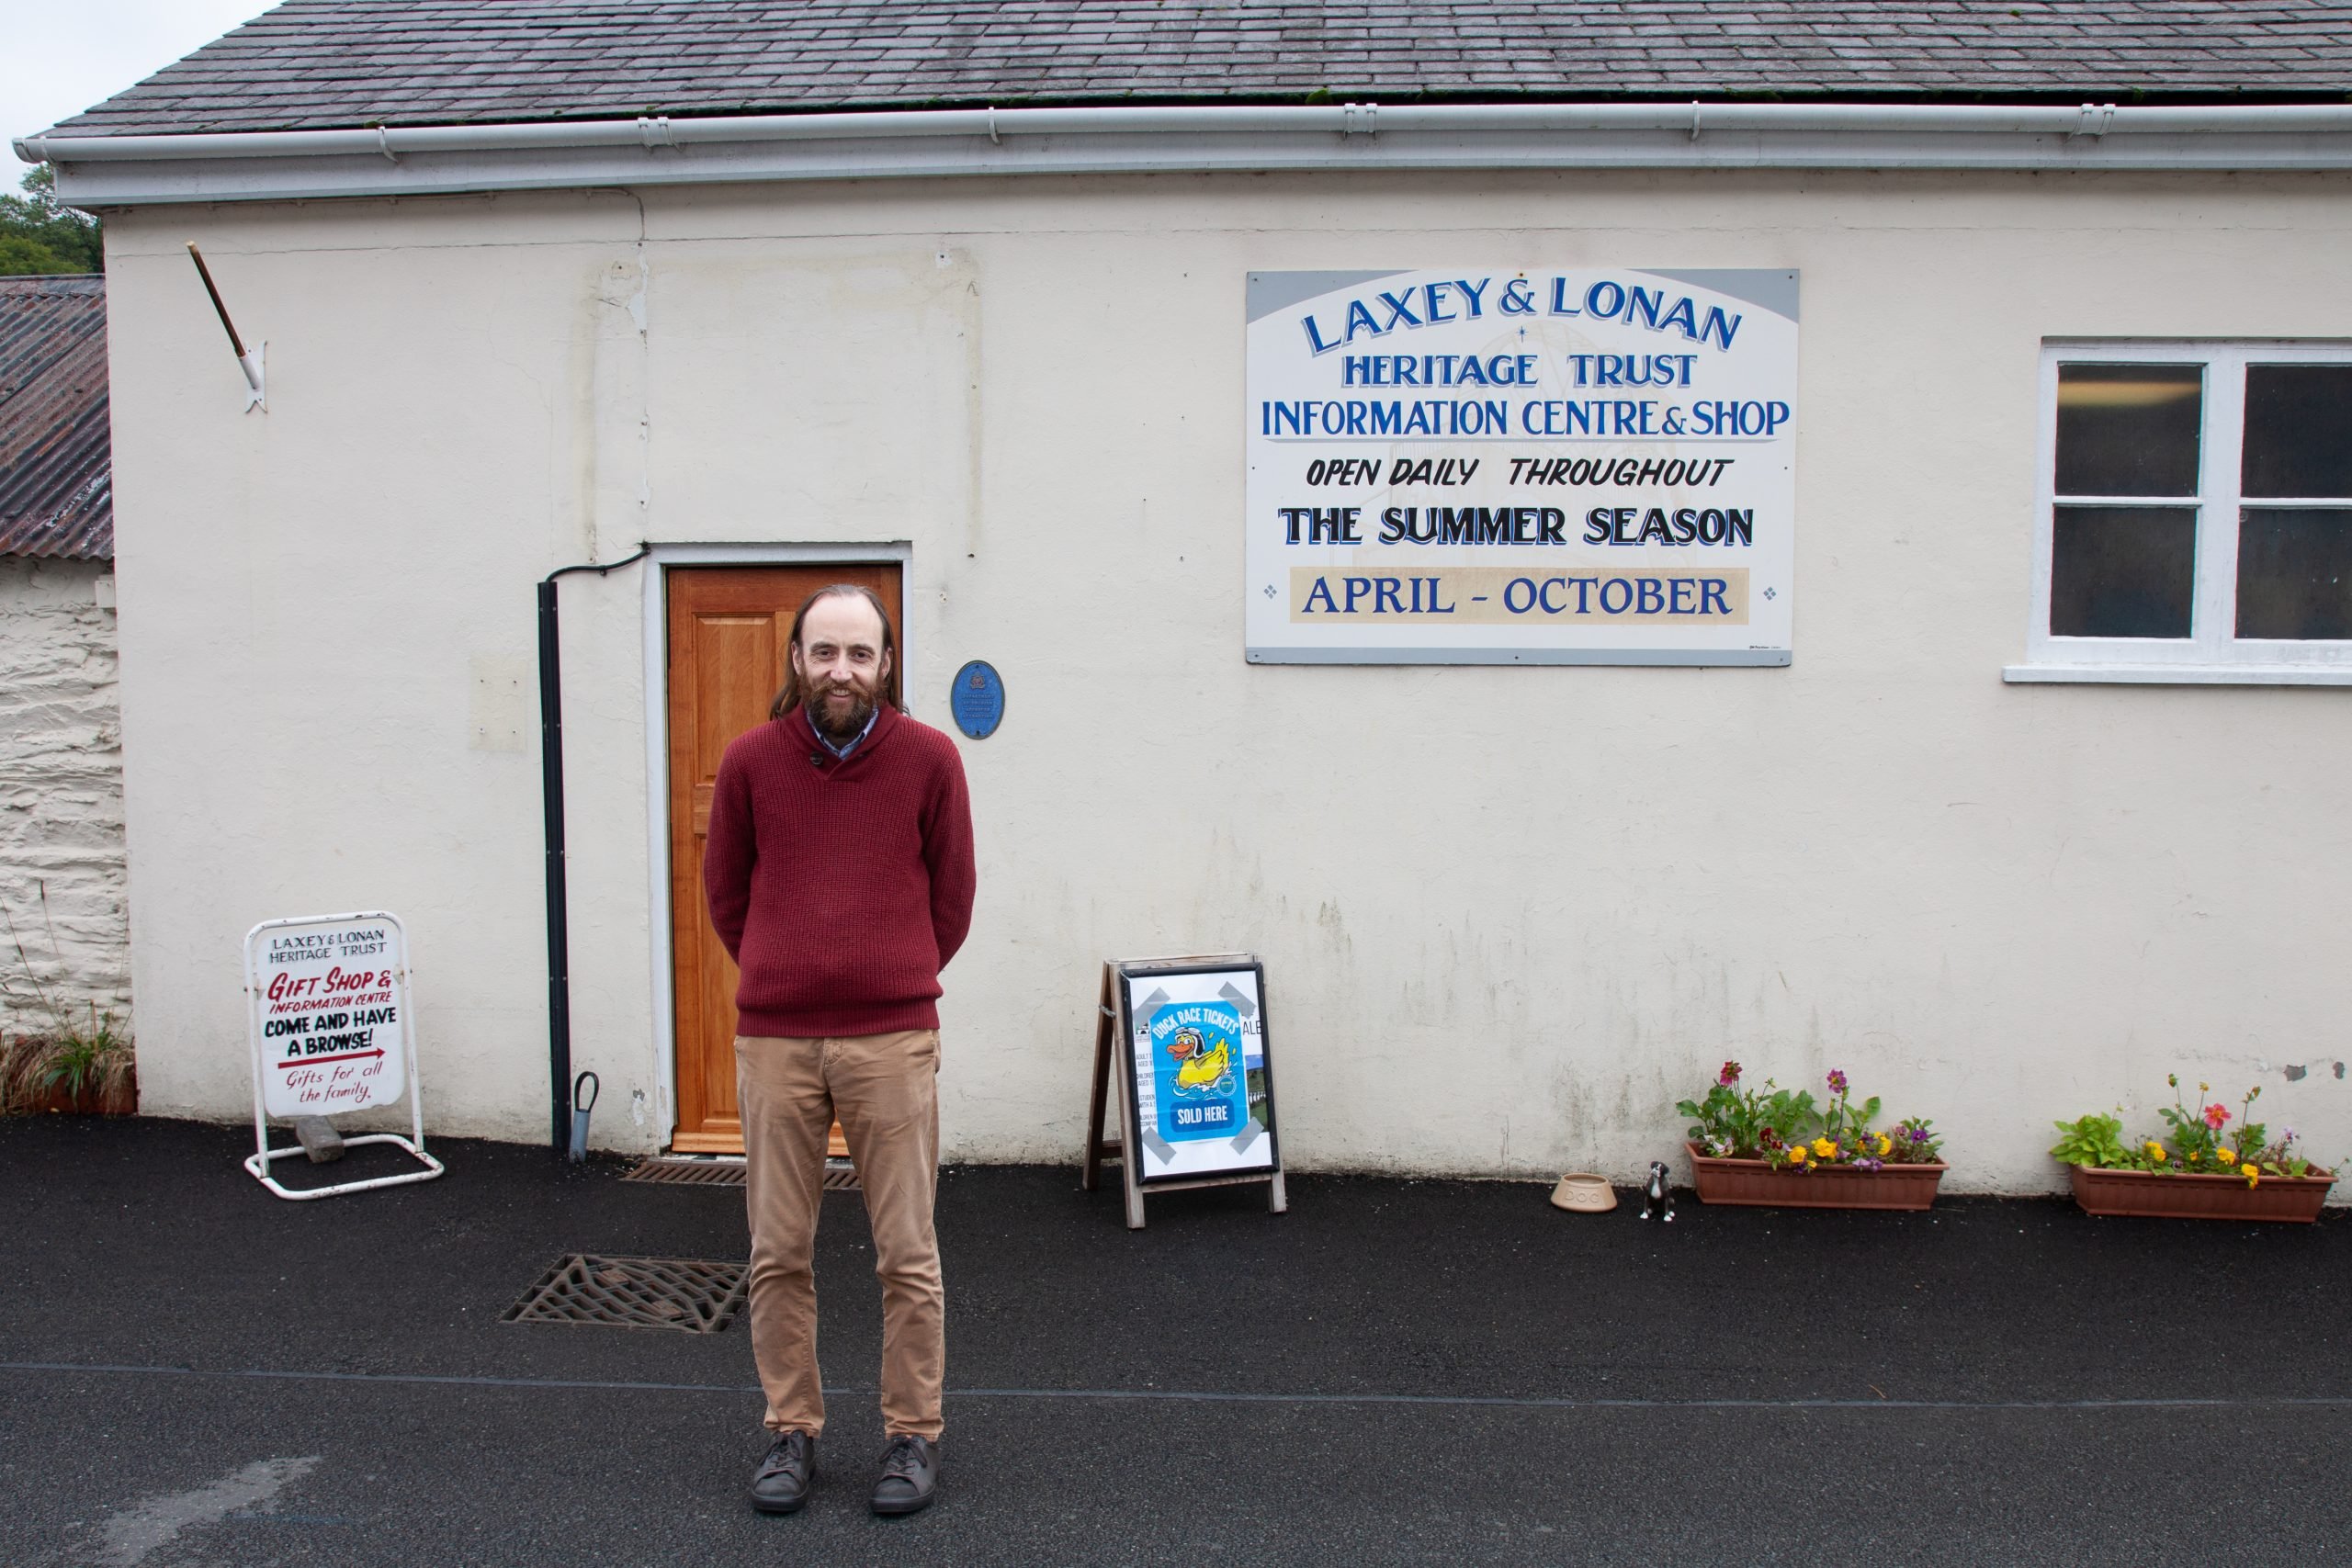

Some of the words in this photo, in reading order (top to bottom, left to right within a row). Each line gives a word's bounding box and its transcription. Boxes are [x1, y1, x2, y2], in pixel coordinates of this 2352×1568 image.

[1300, 278, 1490, 357] LAXEY
[1498, 278, 1537, 315] &
[1548, 276, 1742, 352] LONAN
[1341, 355, 1538, 389] HERITAGE
[1567, 355, 1698, 389] TRUST
[1262, 400, 1508, 435] INFORMATION
[1522, 400, 1658, 435] CENTRE
[1690, 400, 1790, 435] SHOP
[1306, 458, 1382, 486] OPEN
[1388, 458, 1479, 486] DAILY
[1510, 458, 1735, 486] THROUGHOUT
[1278, 507, 1363, 545] THE
[1378, 507, 1566, 545] SUMMER
[1583, 507, 1754, 547] SEASON
[1302, 576, 1455, 614] APRIL
[1504, 577, 1733, 615] OCTOBER
[269, 947, 332, 964] HERITAGE
[340, 942, 387, 956] TRUST
[273, 934, 325, 950] LAXEY
[337, 929, 385, 944] LONAN
[267, 972, 322, 1002] GIFT
[322, 966, 374, 993] SHOP
[378, 969, 391, 988] &
[269, 995, 353, 1014] INFORMATION
[355, 991, 392, 1005] CENTRE
[265, 1017, 310, 1038] COME
[314, 1012, 349, 1032] AND
[353, 1007, 396, 1027] HAVE
[1152, 1013, 1179, 1040] DUCK
[1177, 1008, 1201, 1025] RACE
[1203, 1008, 1239, 1035] TICKETS
[288, 1039, 301, 1056] A
[305, 1028, 373, 1055] BROWSE!
[287, 1070, 323, 1089] Gifts
[332, 1066, 354, 1082] for
[362, 1061, 382, 1077] all
[300, 1088, 321, 1103] the
[324, 1082, 371, 1103] family.
[1177, 1107, 1202, 1125] SOLD
[1204, 1105, 1227, 1122] HERE
[1565, 1190, 1600, 1204] DOG
